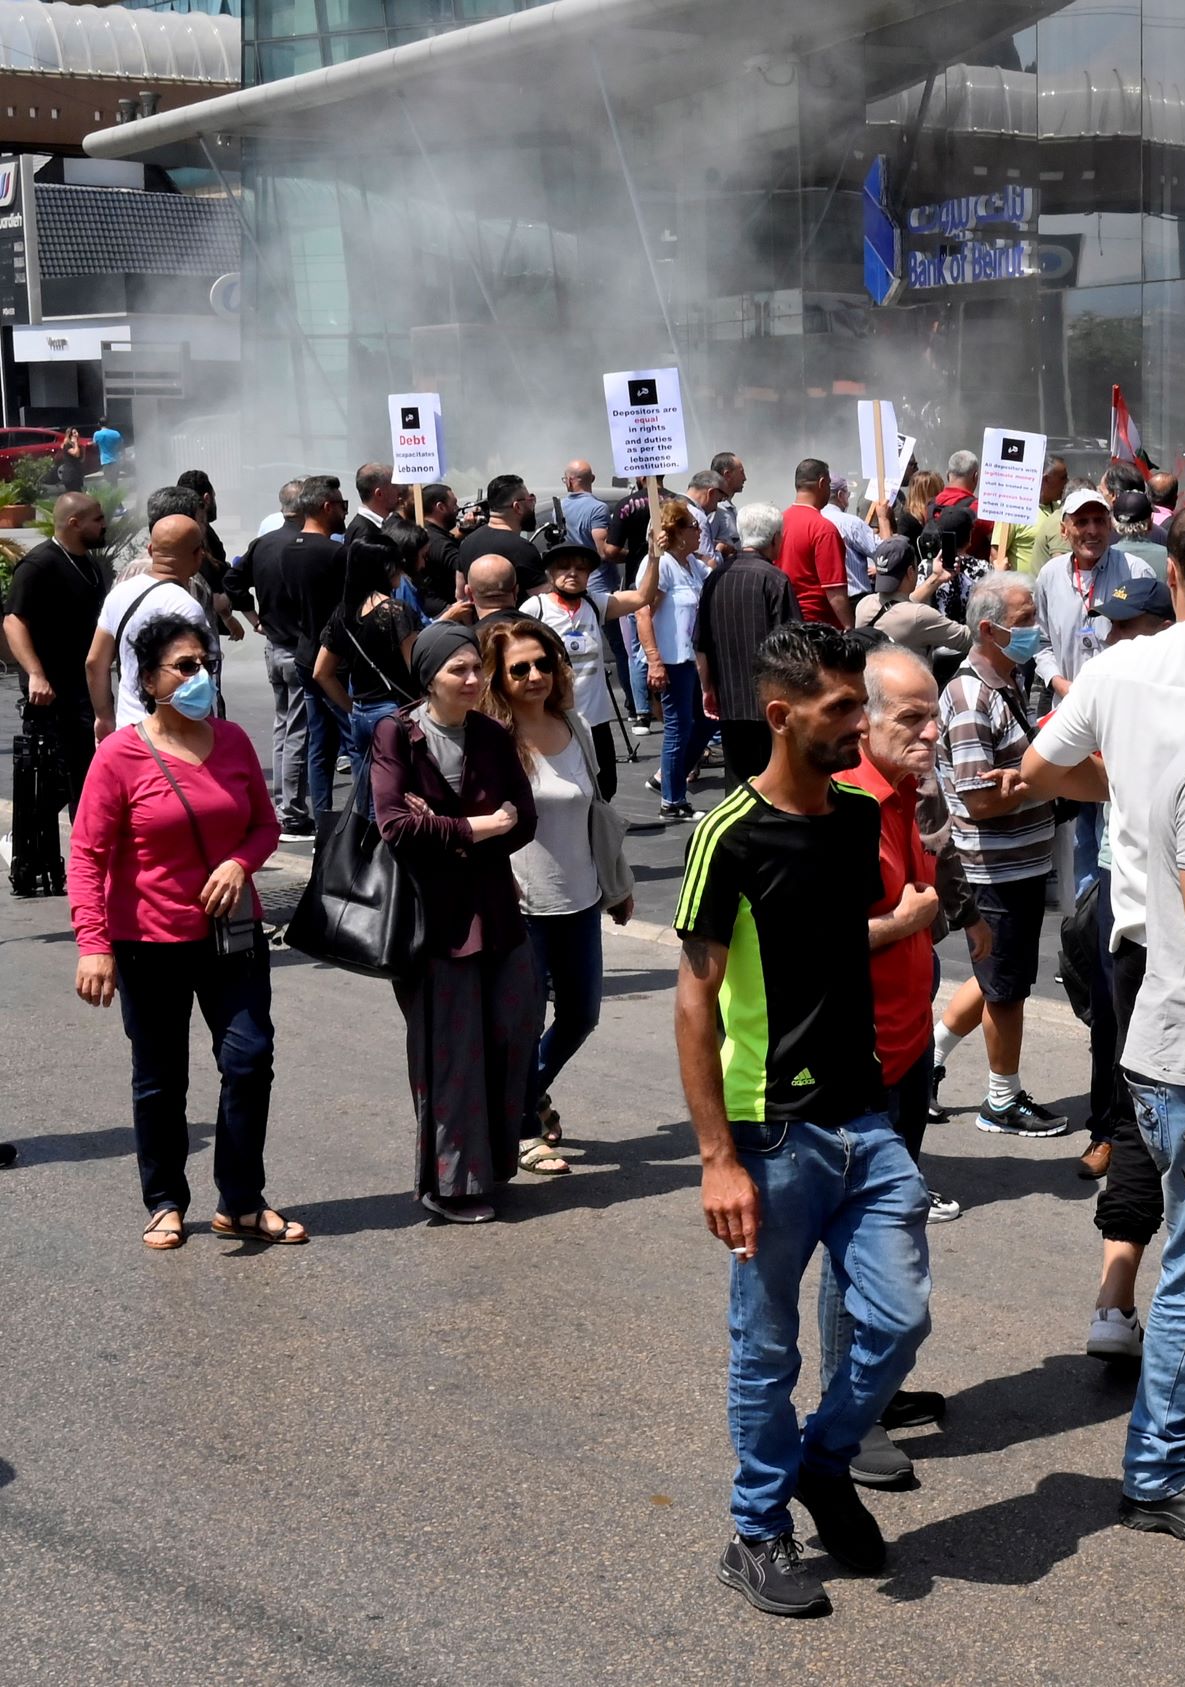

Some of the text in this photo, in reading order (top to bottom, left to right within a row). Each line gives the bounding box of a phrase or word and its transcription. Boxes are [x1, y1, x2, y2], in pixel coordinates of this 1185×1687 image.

[908, 244, 953, 289] Bank
[971, 239, 1032, 282] Beirut
[612, 408, 660, 417] Depositors
[634, 416, 658, 425] equal
[640, 424, 666, 433] rights
[399, 434, 426, 446] Debt
[625, 436, 672, 445] and duties
[630, 455, 671, 463] lebanese
[398, 464, 434, 473] Lebanon
